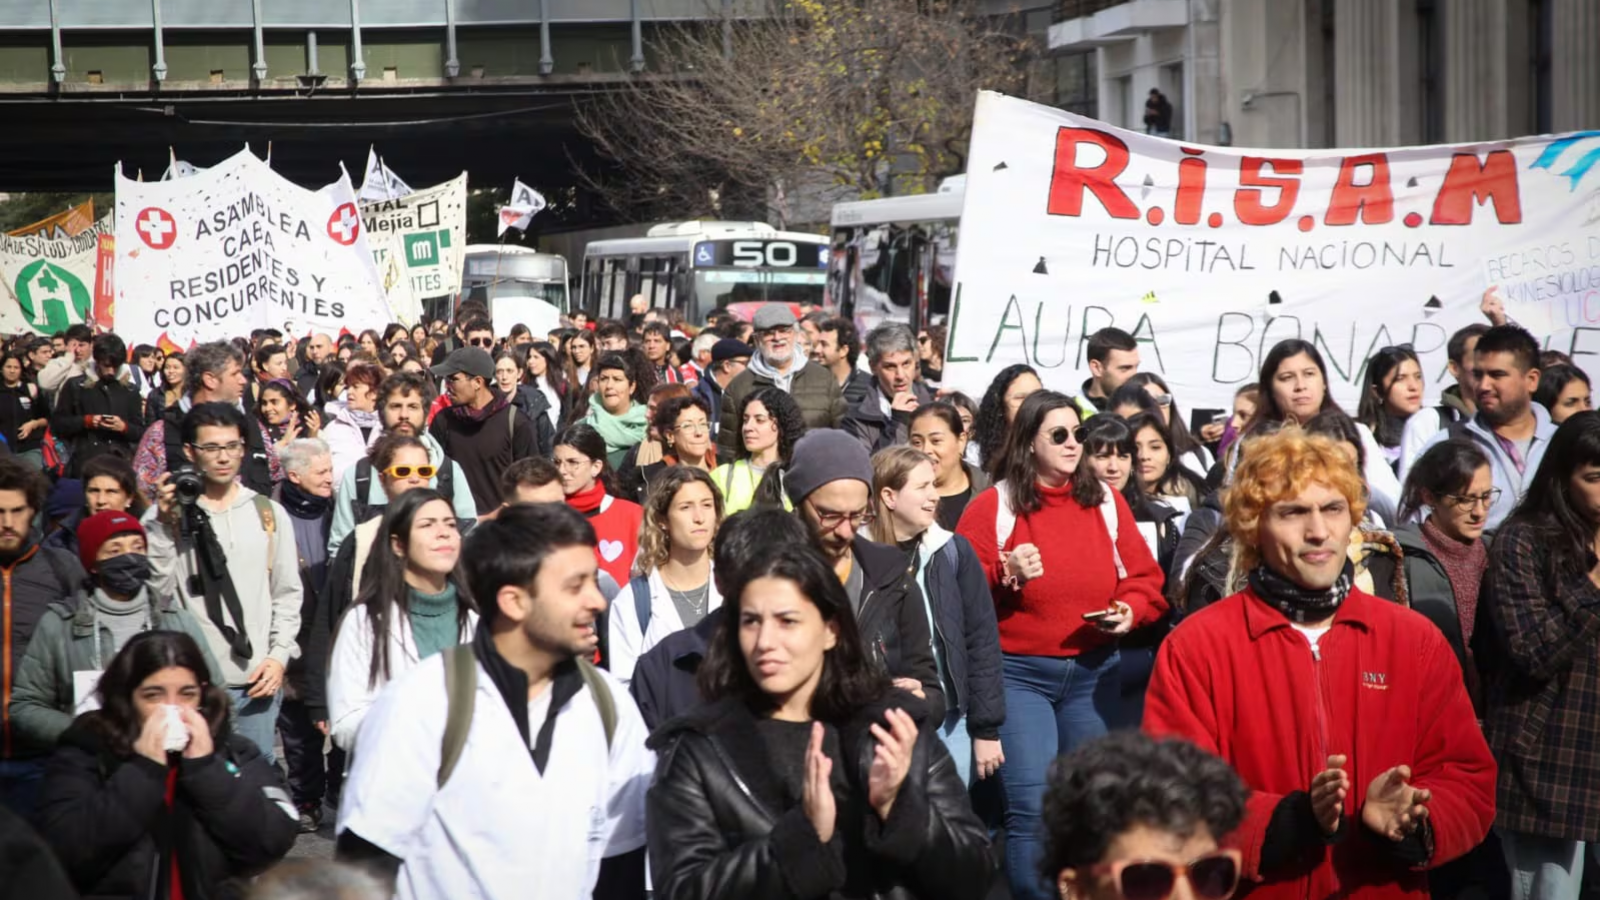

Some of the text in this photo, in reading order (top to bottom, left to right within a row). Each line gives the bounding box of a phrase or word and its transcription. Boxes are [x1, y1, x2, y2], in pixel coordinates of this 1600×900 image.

[196, 191, 311, 242] ASAMBLEA
[223, 220, 276, 258] CABA
[170, 248, 326, 300] RESIDENTES Y
[732, 241, 798, 268] 50
[154, 275, 345, 328] CONCURRENTES
